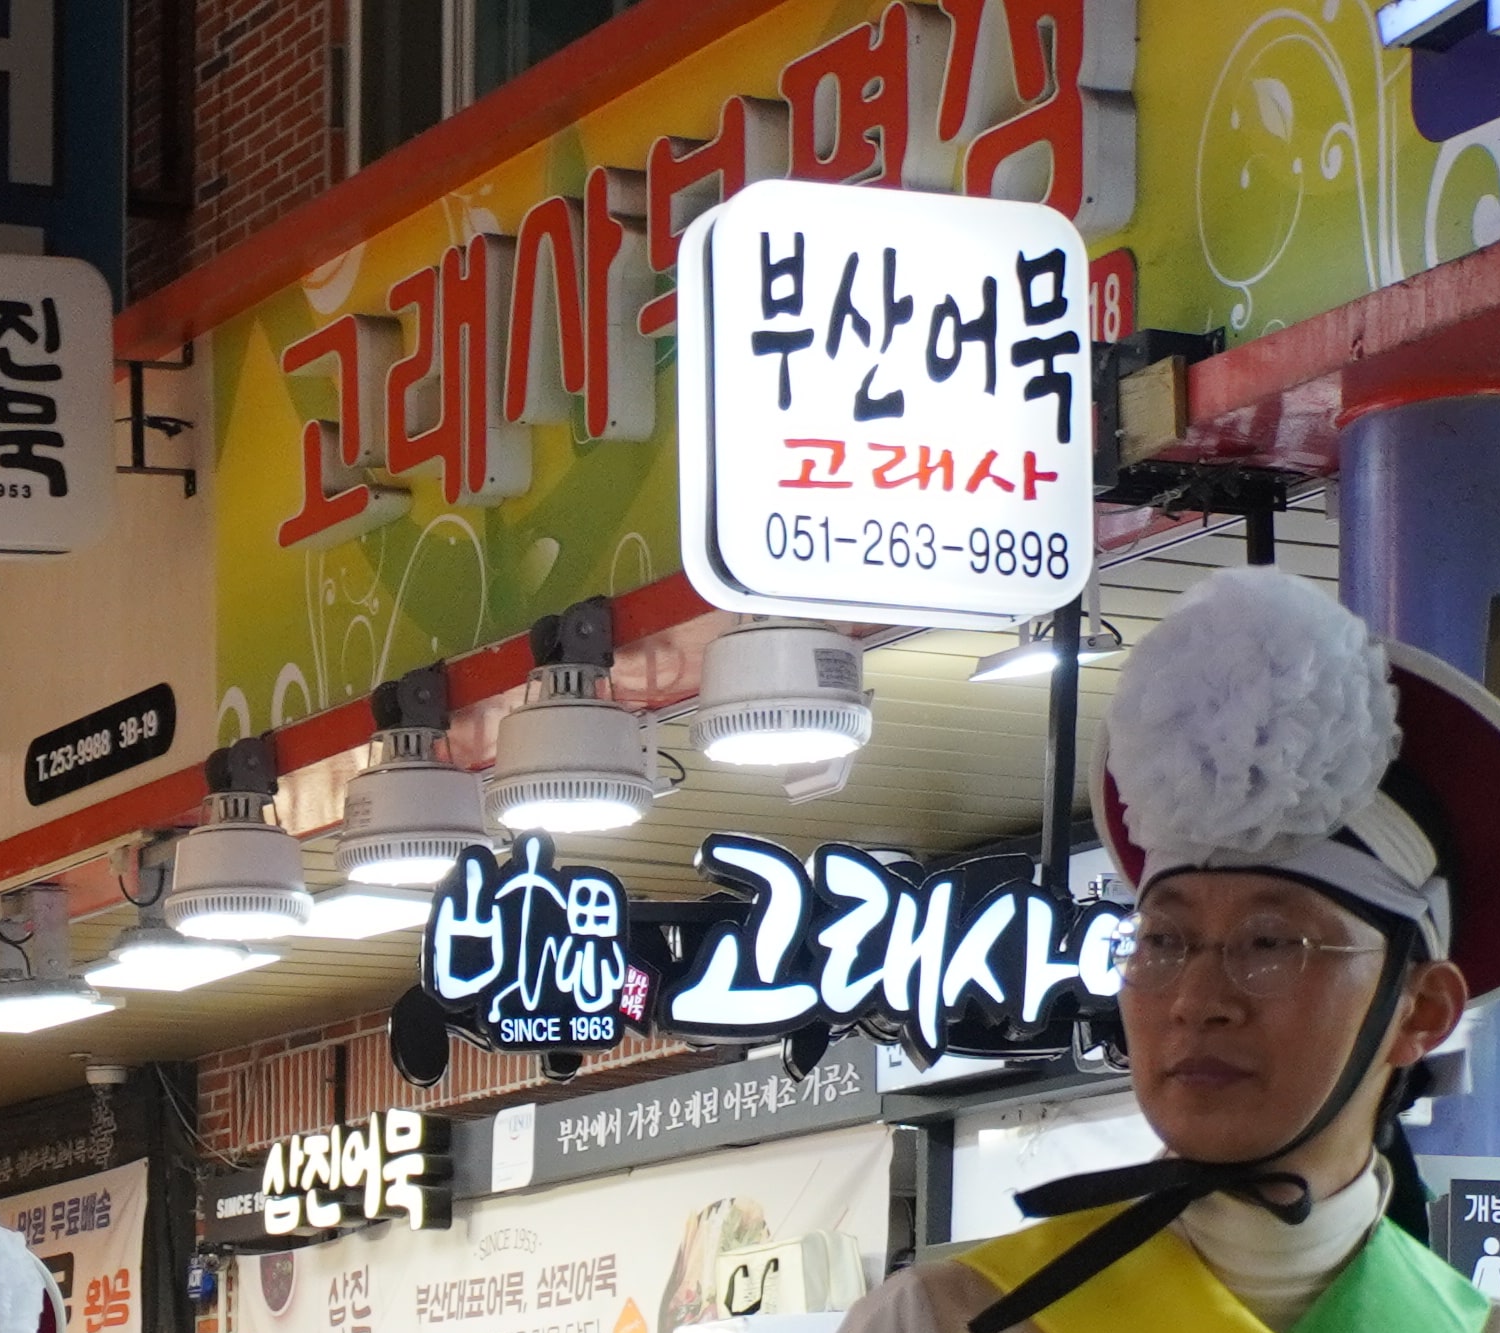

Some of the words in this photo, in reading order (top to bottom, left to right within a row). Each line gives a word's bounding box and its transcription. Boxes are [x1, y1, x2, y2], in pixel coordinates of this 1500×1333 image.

[751, 228, 1082, 444] 부산어묵
[777, 436, 1060, 502] 고래사
[765, 511, 1071, 581] 051-263-9898
[35, 727, 113, 784] T.253-9988
[118, 709, 160, 751] 3B-19
[500, 1016, 562, 1043] SINCE
[568, 1016, 615, 1042] 1963
[556, 1109, 623, 1156] 부산에서
[626, 1100, 663, 1142] 가장
[667, 1087, 718, 1131] 오래된
[801, 1060, 862, 1107] 가공소
[262, 1107, 426, 1236] 삼진어묵
[535, 1254, 618, 1309] 삼진어묵
